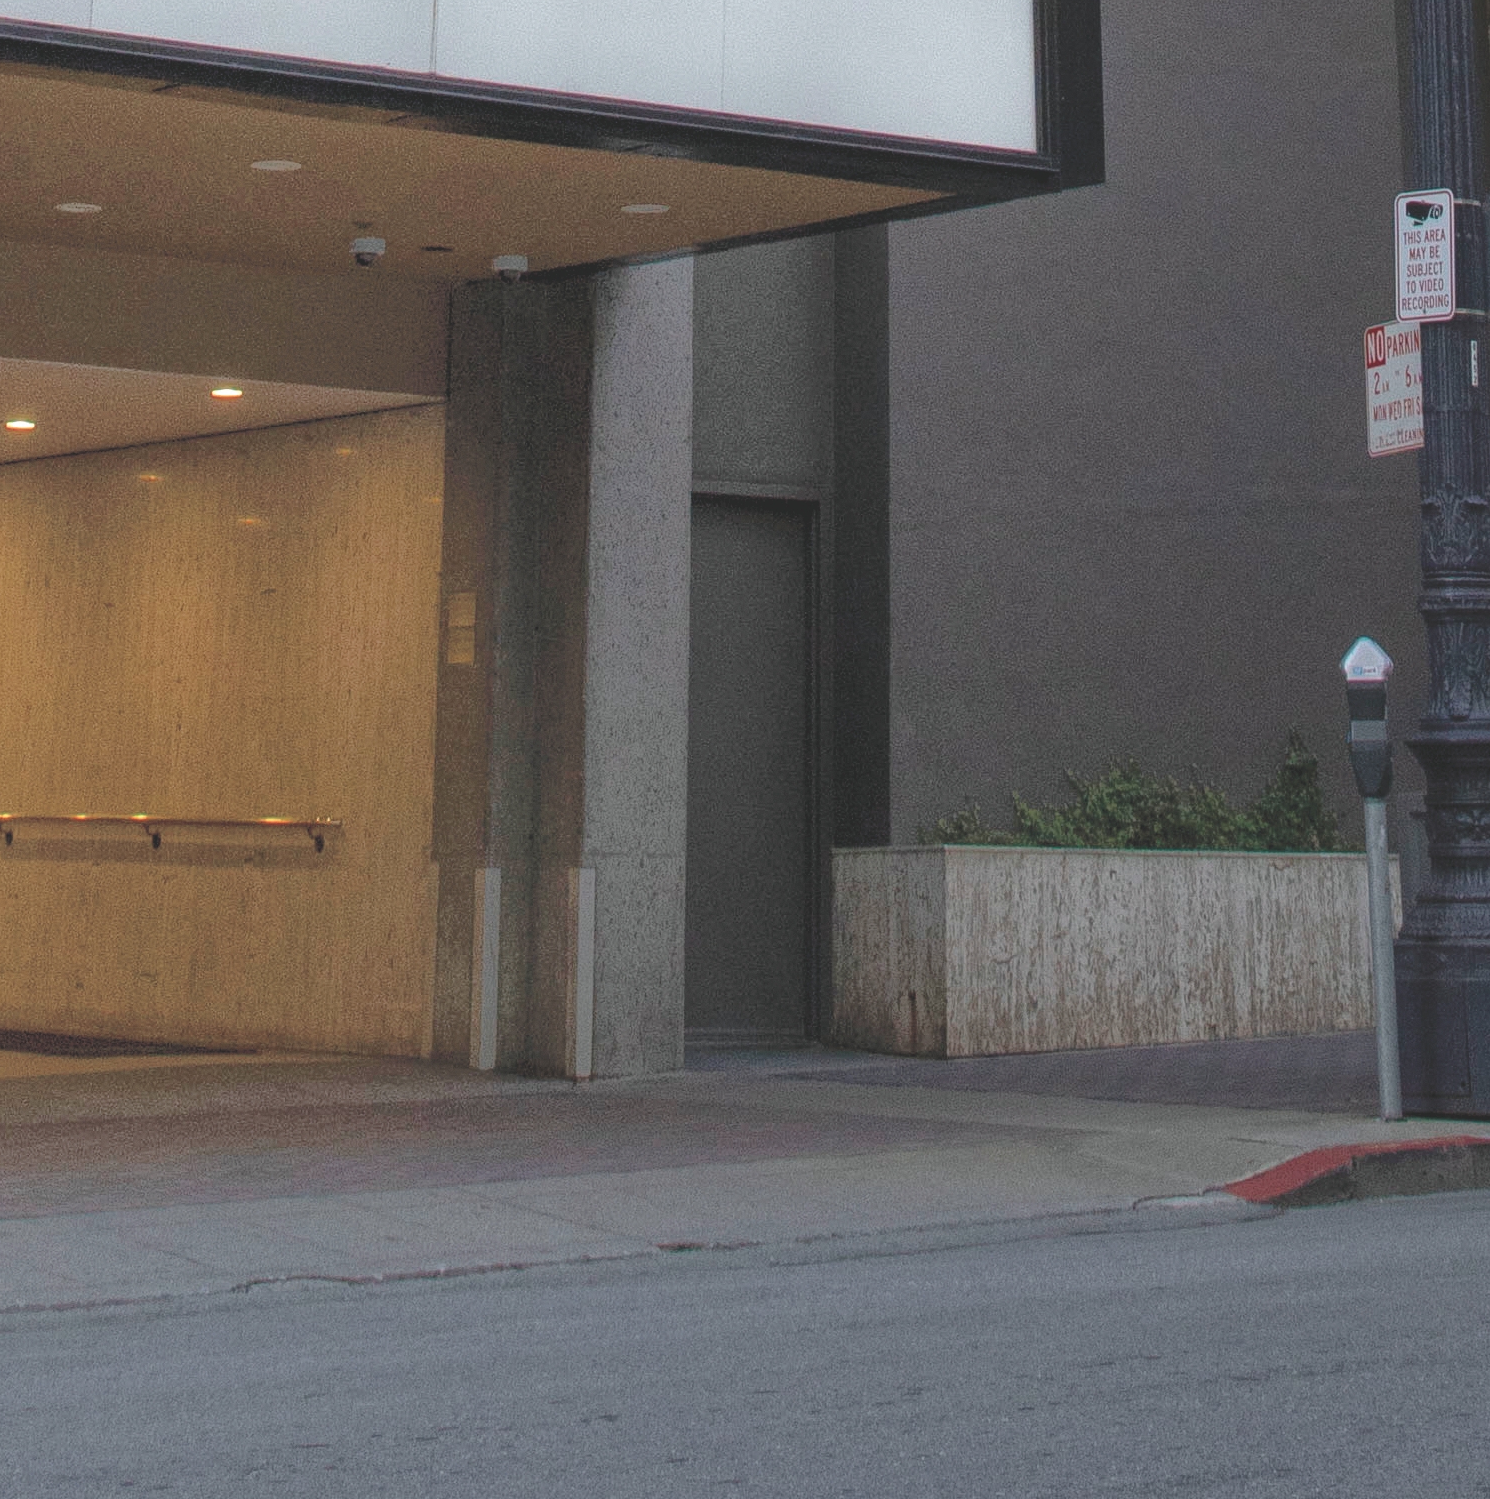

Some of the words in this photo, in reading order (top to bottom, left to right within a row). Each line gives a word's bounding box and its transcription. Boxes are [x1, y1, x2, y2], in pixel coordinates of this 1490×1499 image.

[1403, 232, 1422, 244] THIS
[1424, 229, 1446, 243] AREA
[1409, 246, 1426, 259] MAY
[1429, 245, 1441, 259] BE
[1406, 261, 1443, 276] SUBJECT
[1406, 280, 1417, 294] TO
[1419, 278, 1444, 293] VIDEO
[1402, 294, 1450, 311] RECORDING
[1367, 330, 1384, 365] NO
[1387, 330, 1421, 359] PARKIN
[1373, 372, 1380, 395] 2
[1405, 365, 1412, 388] 6
[1388, 400, 1401, 421] WED
[1403, 399, 1415, 417] FRI
[1396, 428, 1425, 445] CLEANIN
